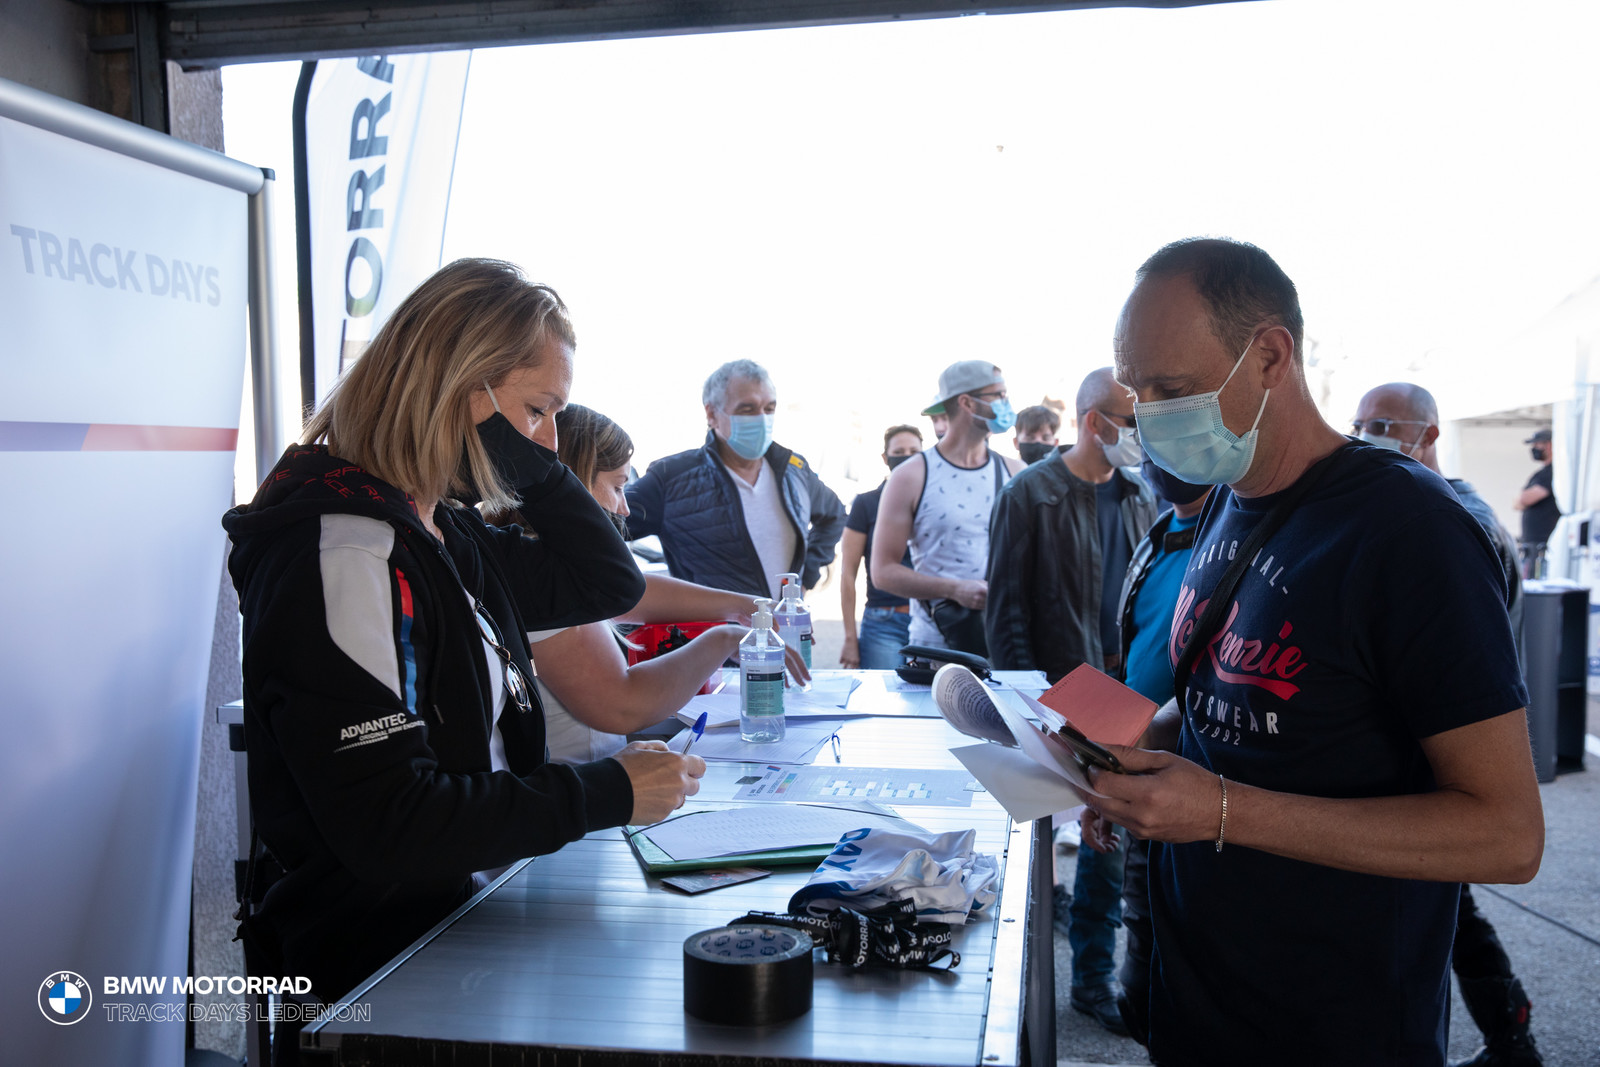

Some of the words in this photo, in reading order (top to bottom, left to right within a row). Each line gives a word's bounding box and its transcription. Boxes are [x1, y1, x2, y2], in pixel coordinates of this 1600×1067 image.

[10, 223, 143, 293] TRACK
[145, 253, 221, 308] DAYS
[340, 712, 407, 741] ADVANTEC
[359, 729, 389, 741] ORIGINAL
[387, 725, 403, 735] BMW
[815, 827, 872, 874] DAY
